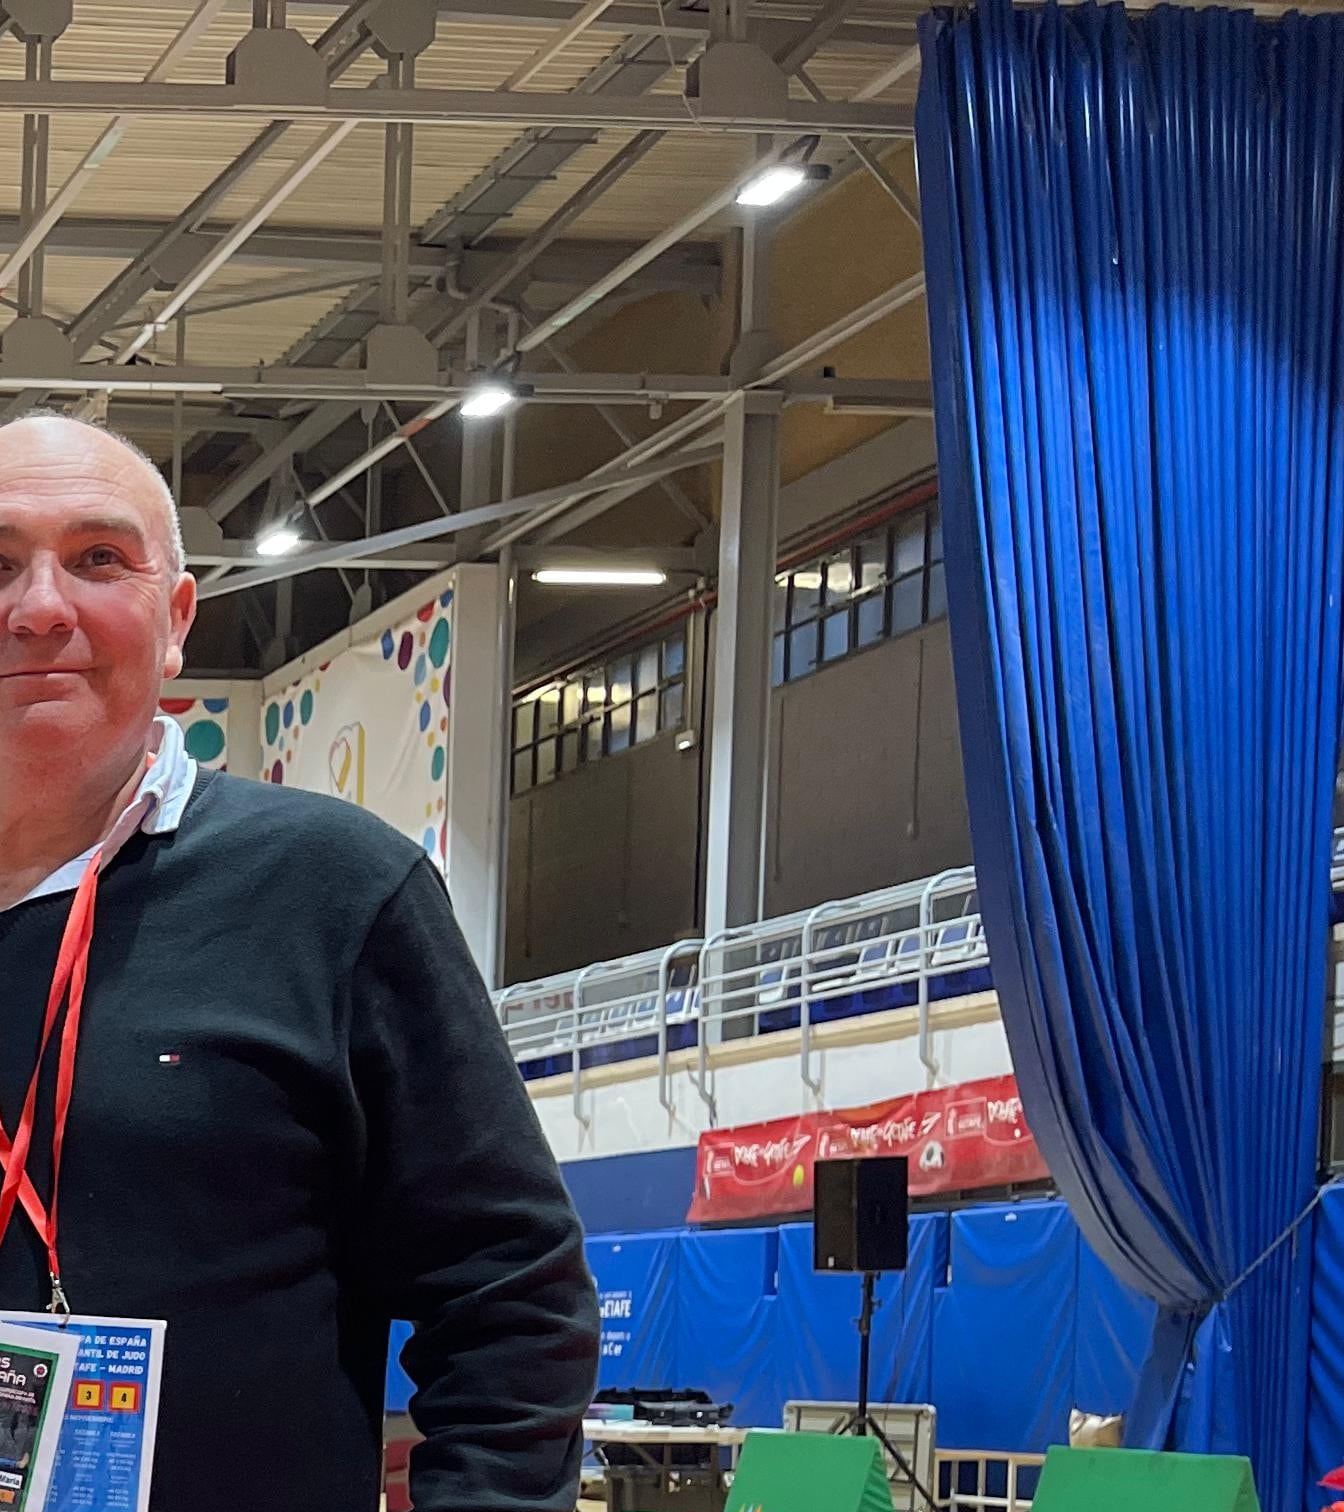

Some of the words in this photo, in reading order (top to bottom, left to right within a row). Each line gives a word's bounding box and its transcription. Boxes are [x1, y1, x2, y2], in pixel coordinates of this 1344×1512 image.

[95, 1335, 107, 1345] DE
[109, 1335, 147, 1347] ESPAÑA
[106, 1350, 119, 1360] DE
[122, 1351, 146, 1360] JUDO
[108, 1364, 144, 1375] MADRID
